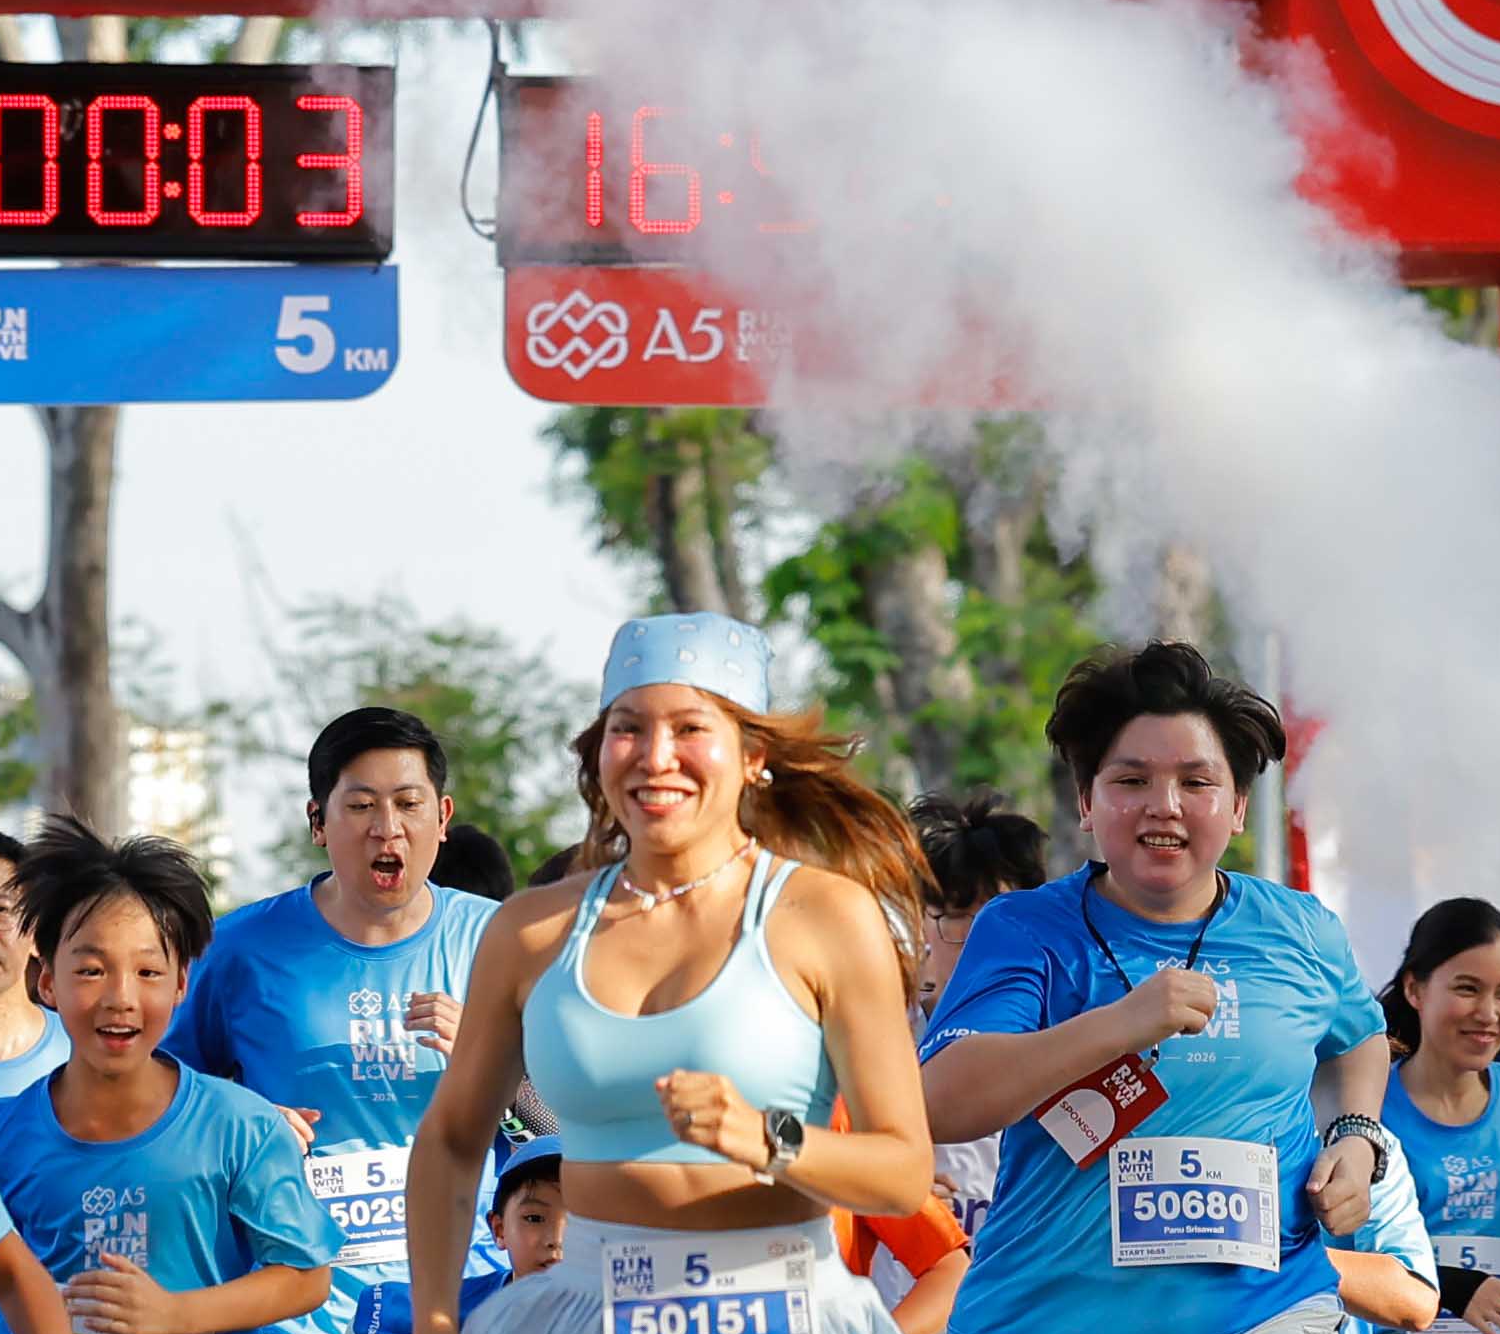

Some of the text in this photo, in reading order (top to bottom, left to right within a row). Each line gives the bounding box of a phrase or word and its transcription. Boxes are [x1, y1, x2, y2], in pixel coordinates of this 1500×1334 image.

[274, 295, 387, 374] 5 KM
[642, 308, 725, 361] A5
[350, 1019, 416, 1044] RUN
[351, 1044, 416, 1063] WITH
[1186, 1051, 1216, 1063] 2026
[352, 1063, 416, 1081] LOVE
[1114, 1063, 1147, 1095] RUN
[1109, 1072, 1139, 1104] WITH
[1058, 1099, 1100, 1145] SPONSOR
[1117, 1150, 1153, 1164] RUN
[1180, 1150, 1222, 1179] 5 KM
[312, 1165, 343, 1180] RUN
[366, 1162, 386, 1187] 5
[1118, 1164, 1154, 1174] WITH
[1118, 1173, 1154, 1183] LOVE
[313, 1176, 344, 1187] WITH
[1448, 1170, 1497, 1194] RUN
[119, 1187, 146, 1207] A5
[1134, 1190, 1249, 1221] 50680
[1447, 1192, 1495, 1205] WITH
[330, 1195, 407, 1227] 5029
[1442, 1206, 1495, 1221] LOVE
[1120, 1248, 1145, 1256] START
[1460, 1246, 1477, 1269] 5
[612, 1256, 652, 1275] RUN
[685, 1252, 710, 1286] 5
[614, 1272, 653, 1285] WITH
